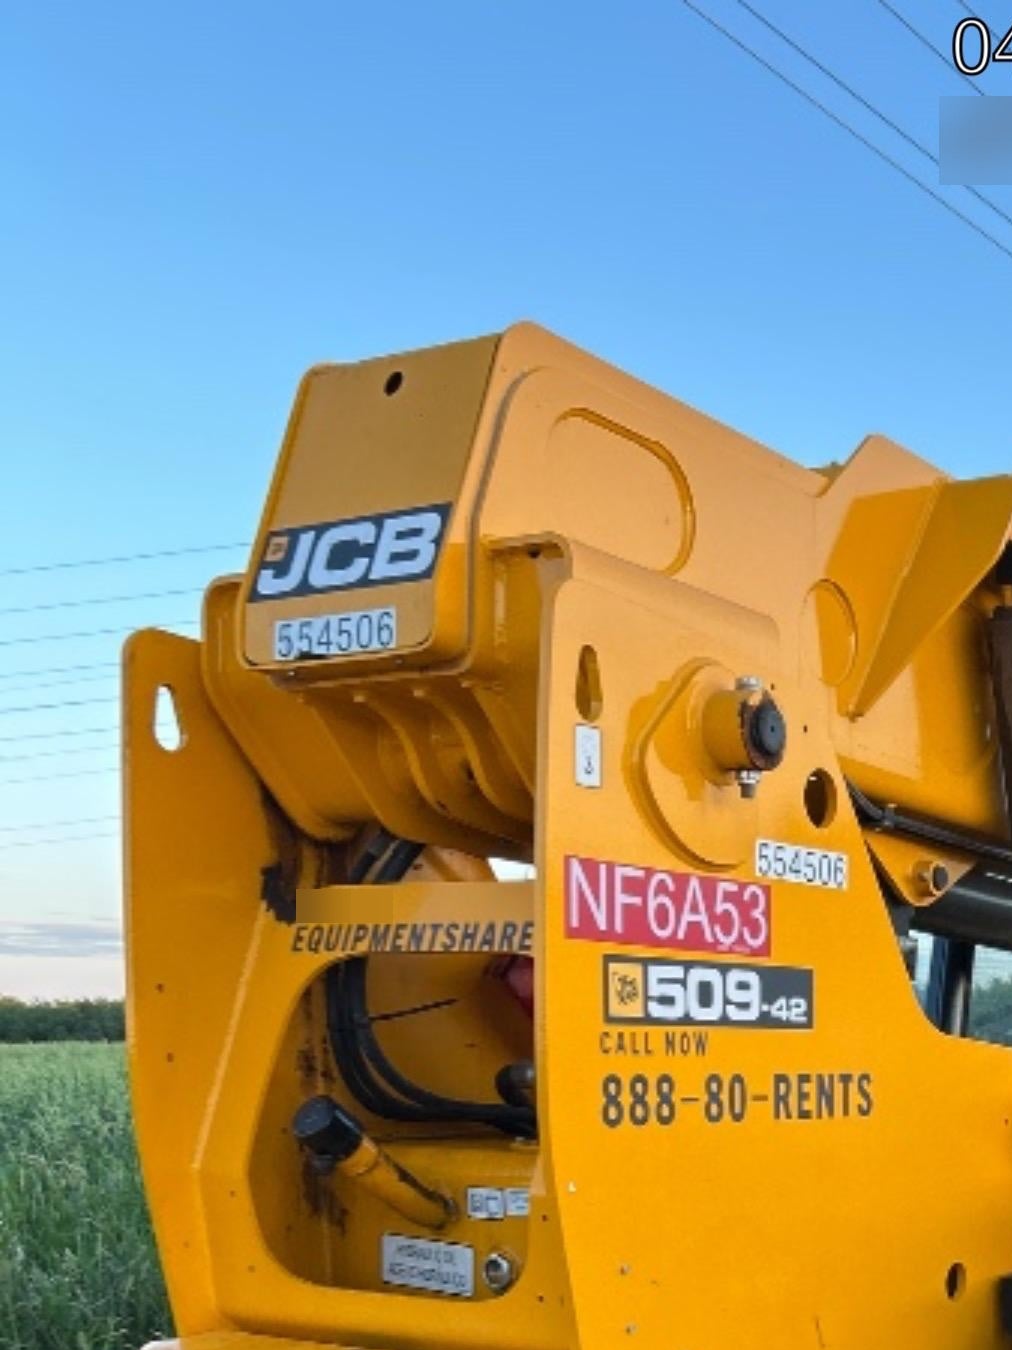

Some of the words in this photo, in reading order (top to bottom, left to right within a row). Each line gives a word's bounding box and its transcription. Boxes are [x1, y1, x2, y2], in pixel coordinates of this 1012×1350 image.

[256, 512, 442, 595] JCB
[277, 611, 394, 658] 554506
[757, 841, 845, 888] 554506
[569, 857, 767, 947] NF6A53
[292, 922, 534, 952] EQUIPMENTSHARE
[600, 1031, 654, 1055] CALL
[665, 1032, 708, 1057] NOW
[601, 1072, 874, 1129] 888-80-RENTS
